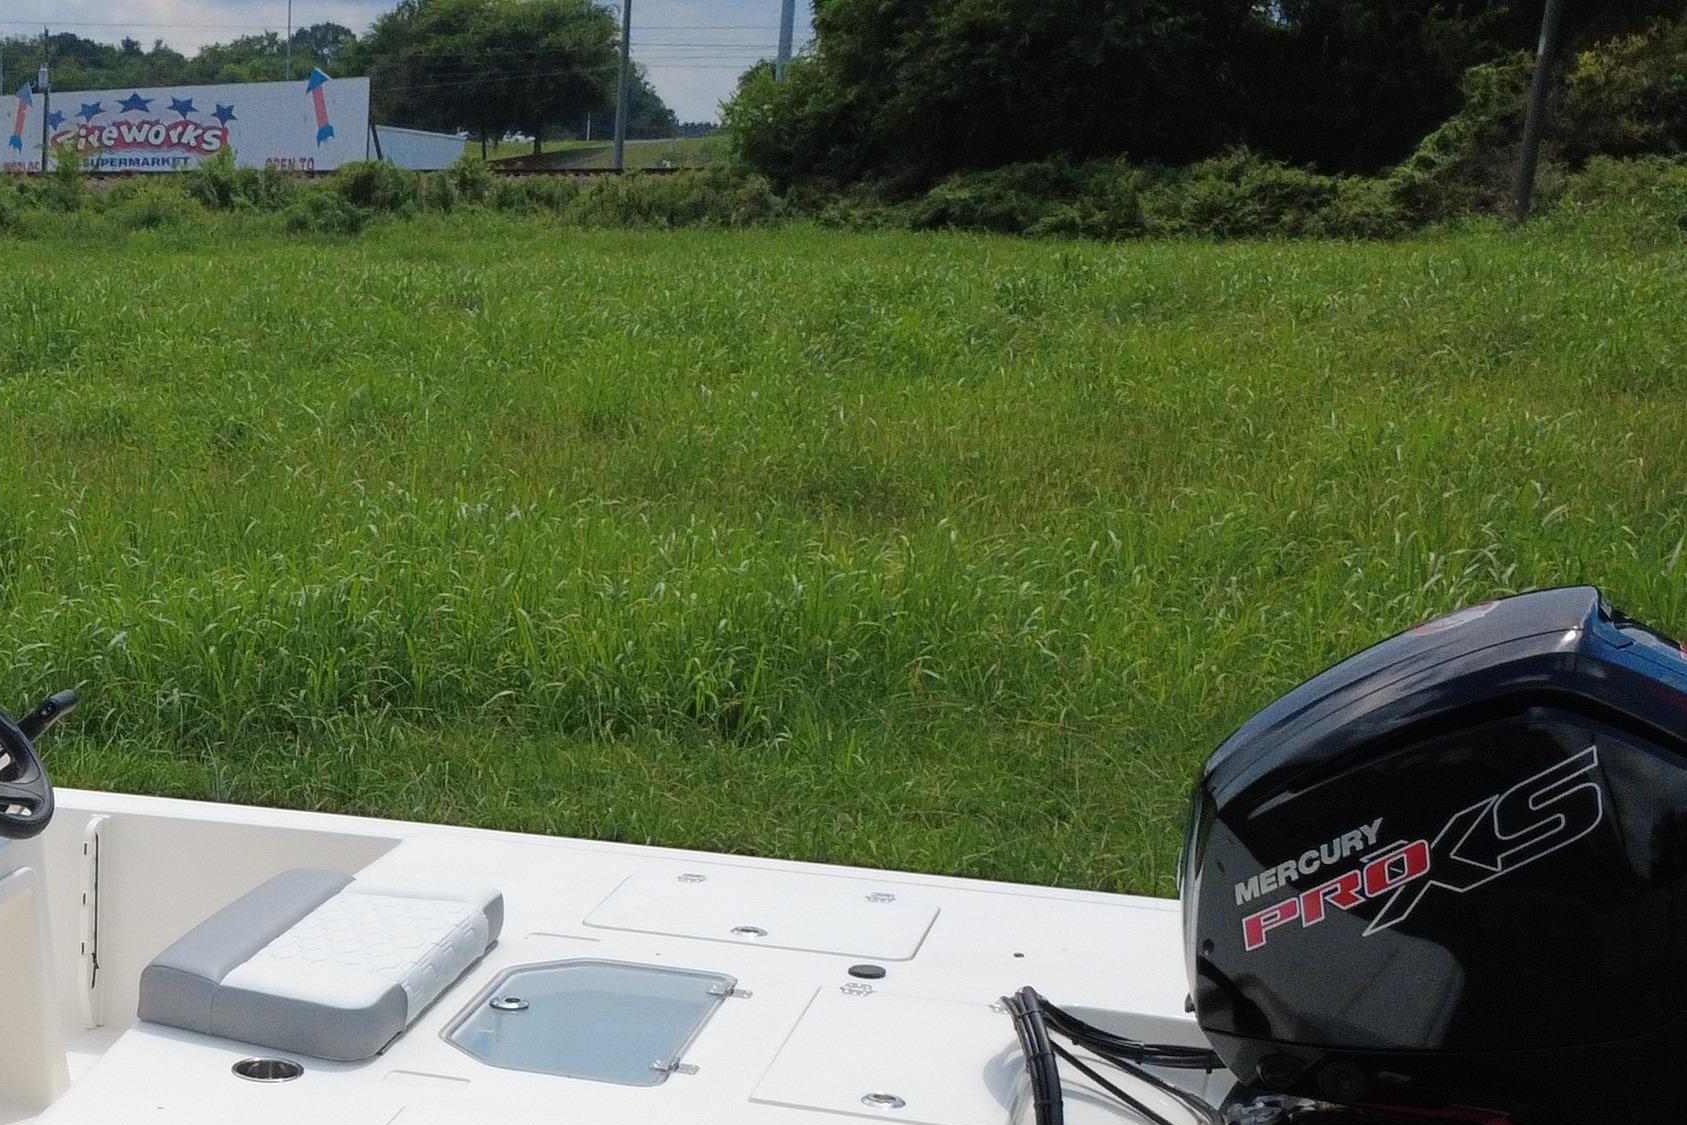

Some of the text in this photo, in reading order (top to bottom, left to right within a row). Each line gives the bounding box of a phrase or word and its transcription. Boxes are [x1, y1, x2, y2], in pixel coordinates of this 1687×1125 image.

[1234, 817, 1383, 906] MERCURY
[1242, 745, 1603, 951] PRO XS
